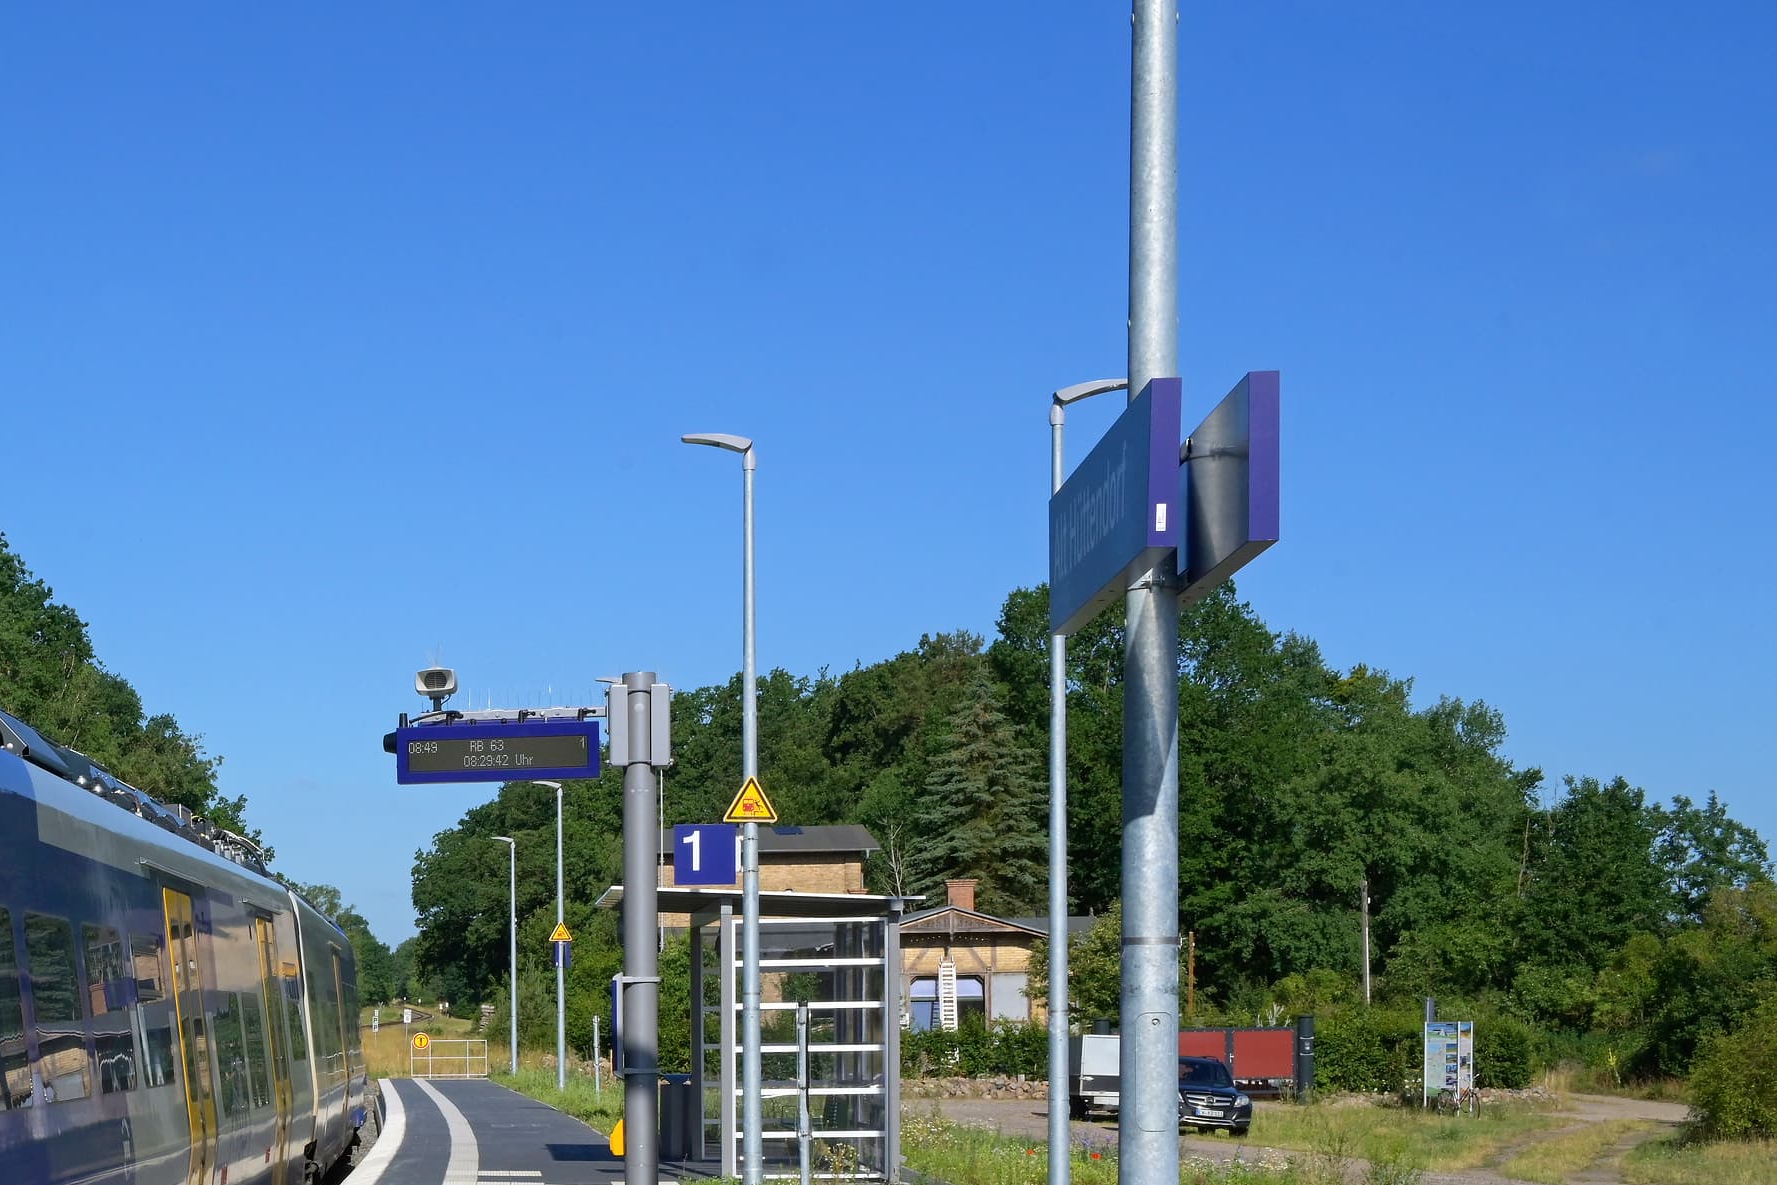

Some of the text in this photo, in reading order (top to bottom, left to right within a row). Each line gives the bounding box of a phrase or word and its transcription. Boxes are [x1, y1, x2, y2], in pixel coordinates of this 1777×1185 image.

[408, 737, 586, 754] 08:49 RB 63 1
[463, 754, 534, 767] 08:29:42 Uhr
[683, 830, 700, 871] 1
